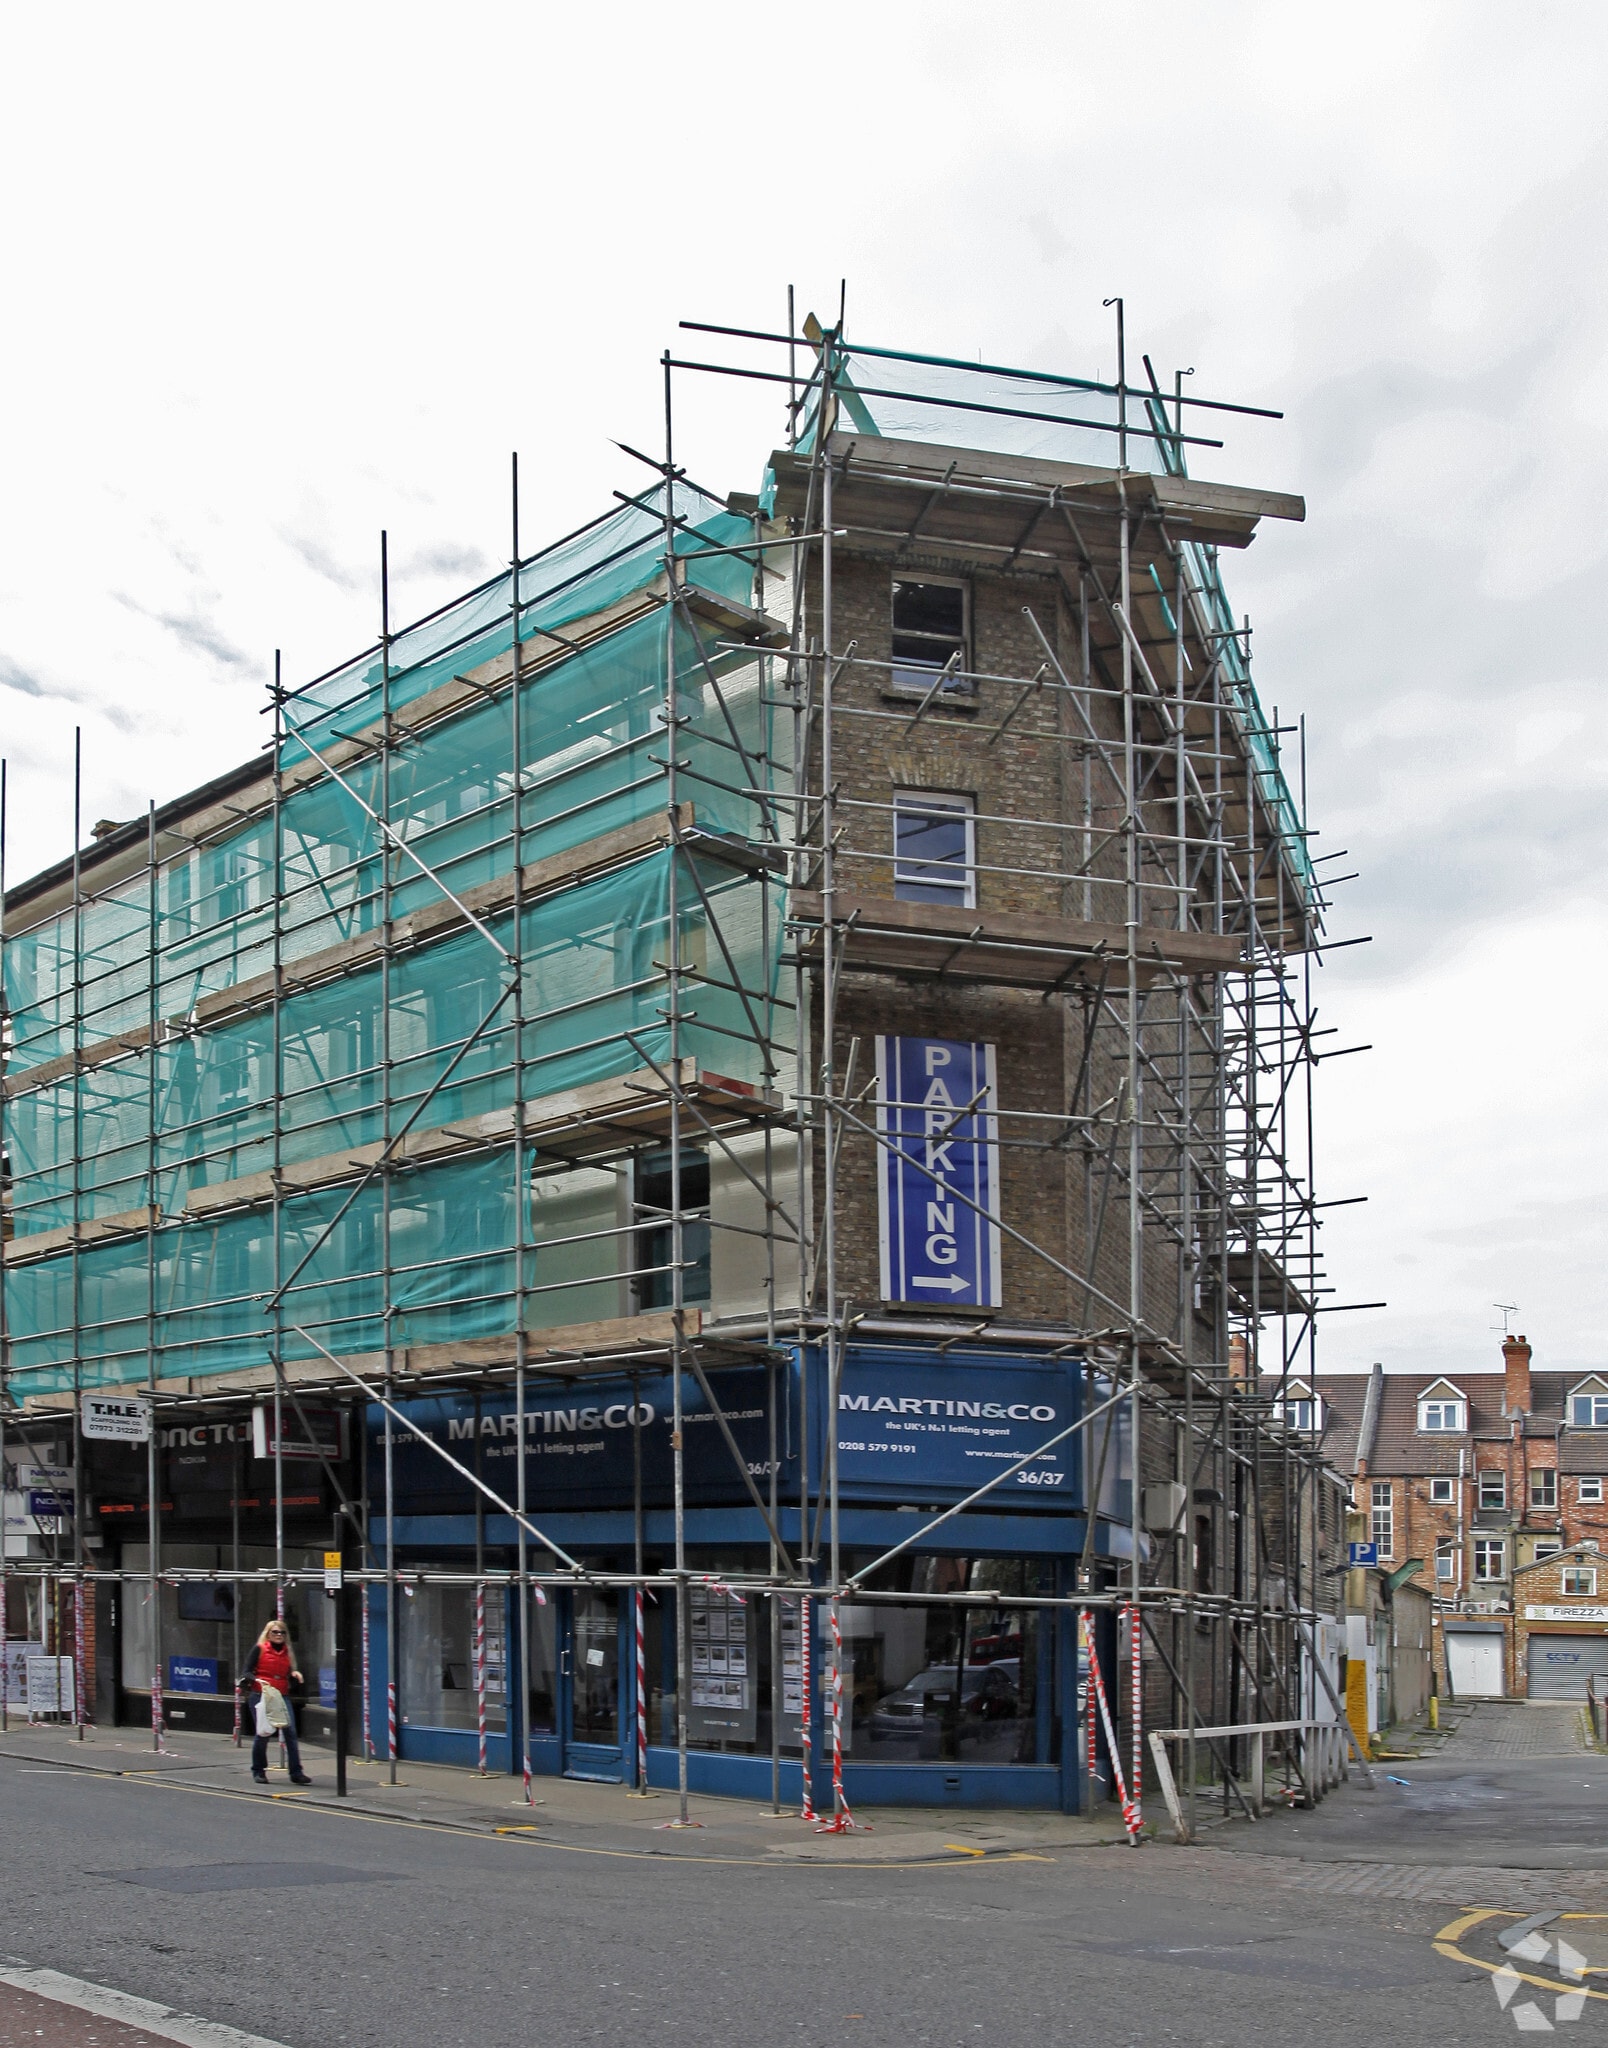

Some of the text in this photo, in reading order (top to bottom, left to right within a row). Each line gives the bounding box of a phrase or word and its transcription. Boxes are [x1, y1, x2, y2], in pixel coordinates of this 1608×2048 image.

[923, 1046, 958, 1265] PARKING
[838, 1394, 1056, 1422] MARTIN&CO
[448, 1403, 656, 1440] MARTIN&CO
[885, 1421, 902, 1431] the
[904, 1422, 926, 1432] UK's
[949, 1424, 980, 1436] letting
[982, 1428, 1010, 1437] agent
[544, 1442, 574, 1455] letting
[576, 1441, 604, 1454] agent
[838, 1441, 916, 1454] 0208 579 9191
[965, 1450, 1057, 1461] www.martinc.com
[1017, 1471, 1064, 1485] 36/37
[1355, 1543, 1371, 1560] P
[1553, 1607, 1604, 1617] FIREZZA
[174, 1666, 211, 1678] NOKIA
